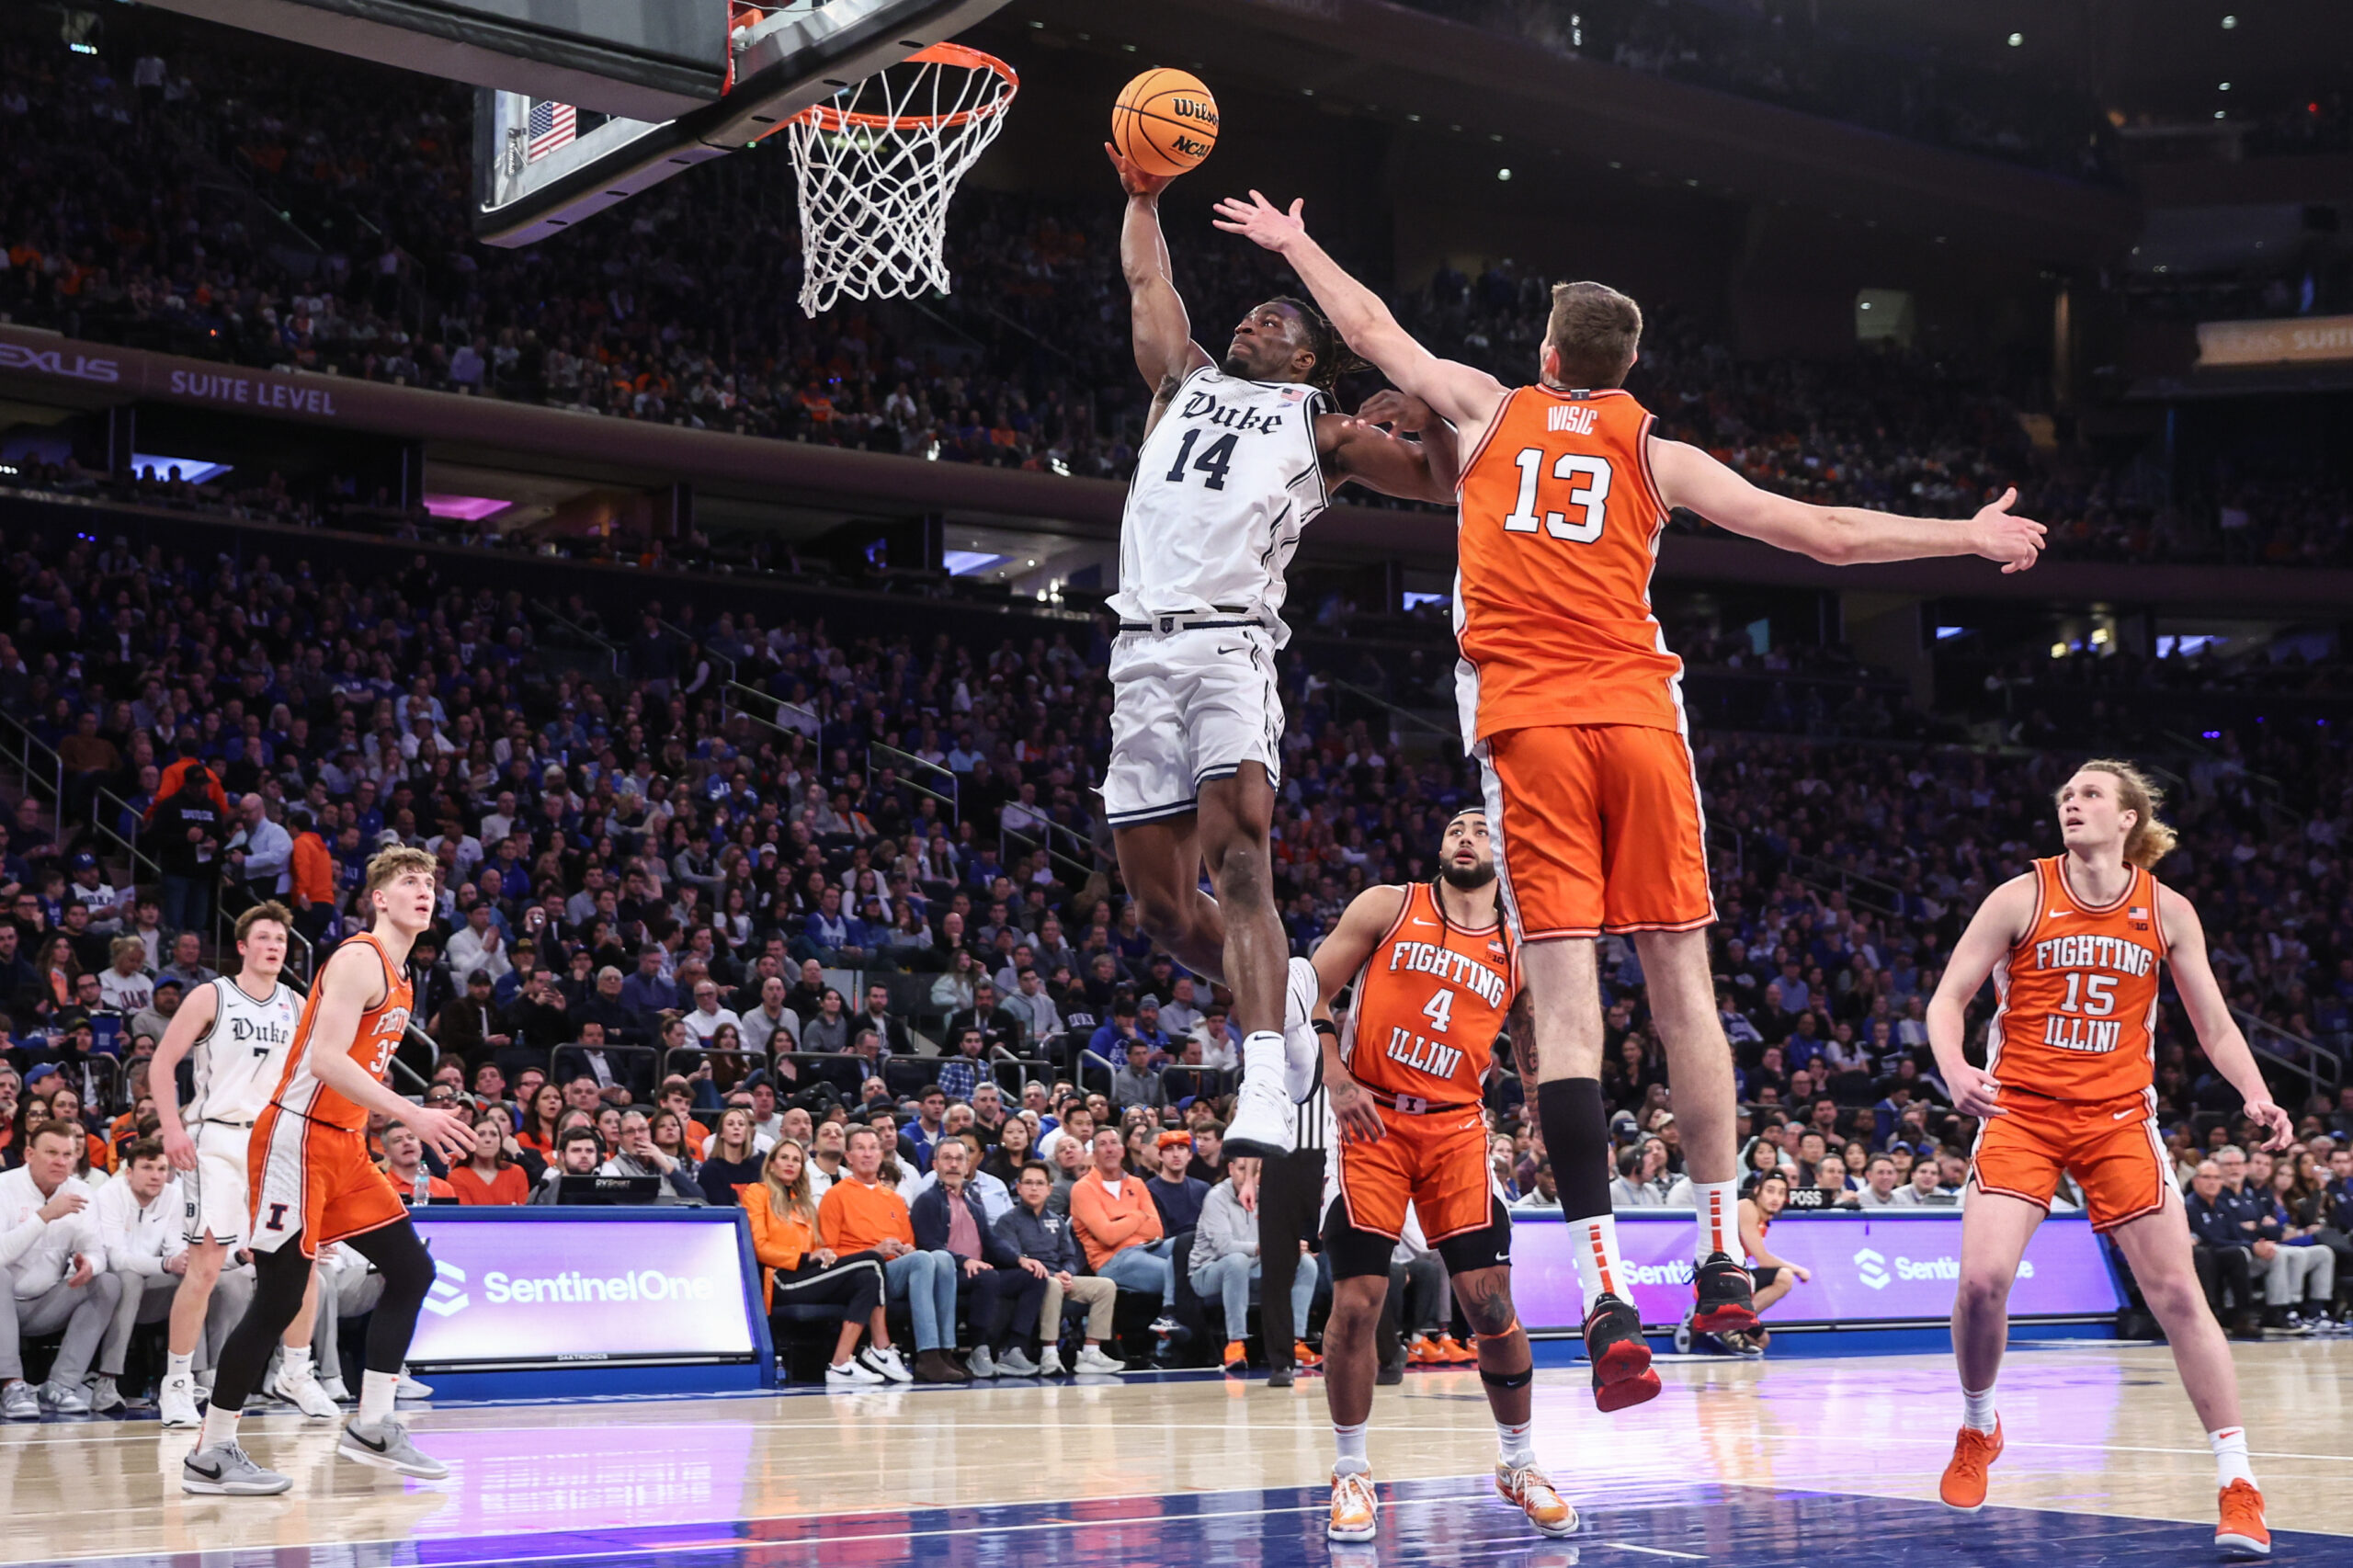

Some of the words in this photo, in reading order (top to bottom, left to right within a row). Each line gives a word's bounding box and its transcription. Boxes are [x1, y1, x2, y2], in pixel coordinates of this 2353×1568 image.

[170, 369, 249, 403] SUITE
[256, 382, 336, 415] LEVEL
[1178, 391, 1282, 435] Duke
[1165, 428, 1239, 491] 14
[1504, 447, 1613, 544] 13
[1389, 941, 1506, 1009] FIGHTING
[2036, 935, 2153, 978] FIGHTING
[1422, 988, 1455, 1033] 4
[2061, 971, 2119, 1017] 15
[231, 1017, 289, 1044] Duke
[2044, 1014, 2121, 1052] ILLINI
[250, 1047, 270, 1083] 7
[1386, 1026, 1462, 1080] ILLINI
[1789, 1190, 1823, 1206] POSS
[483, 1269, 714, 1303] SentinelOne
